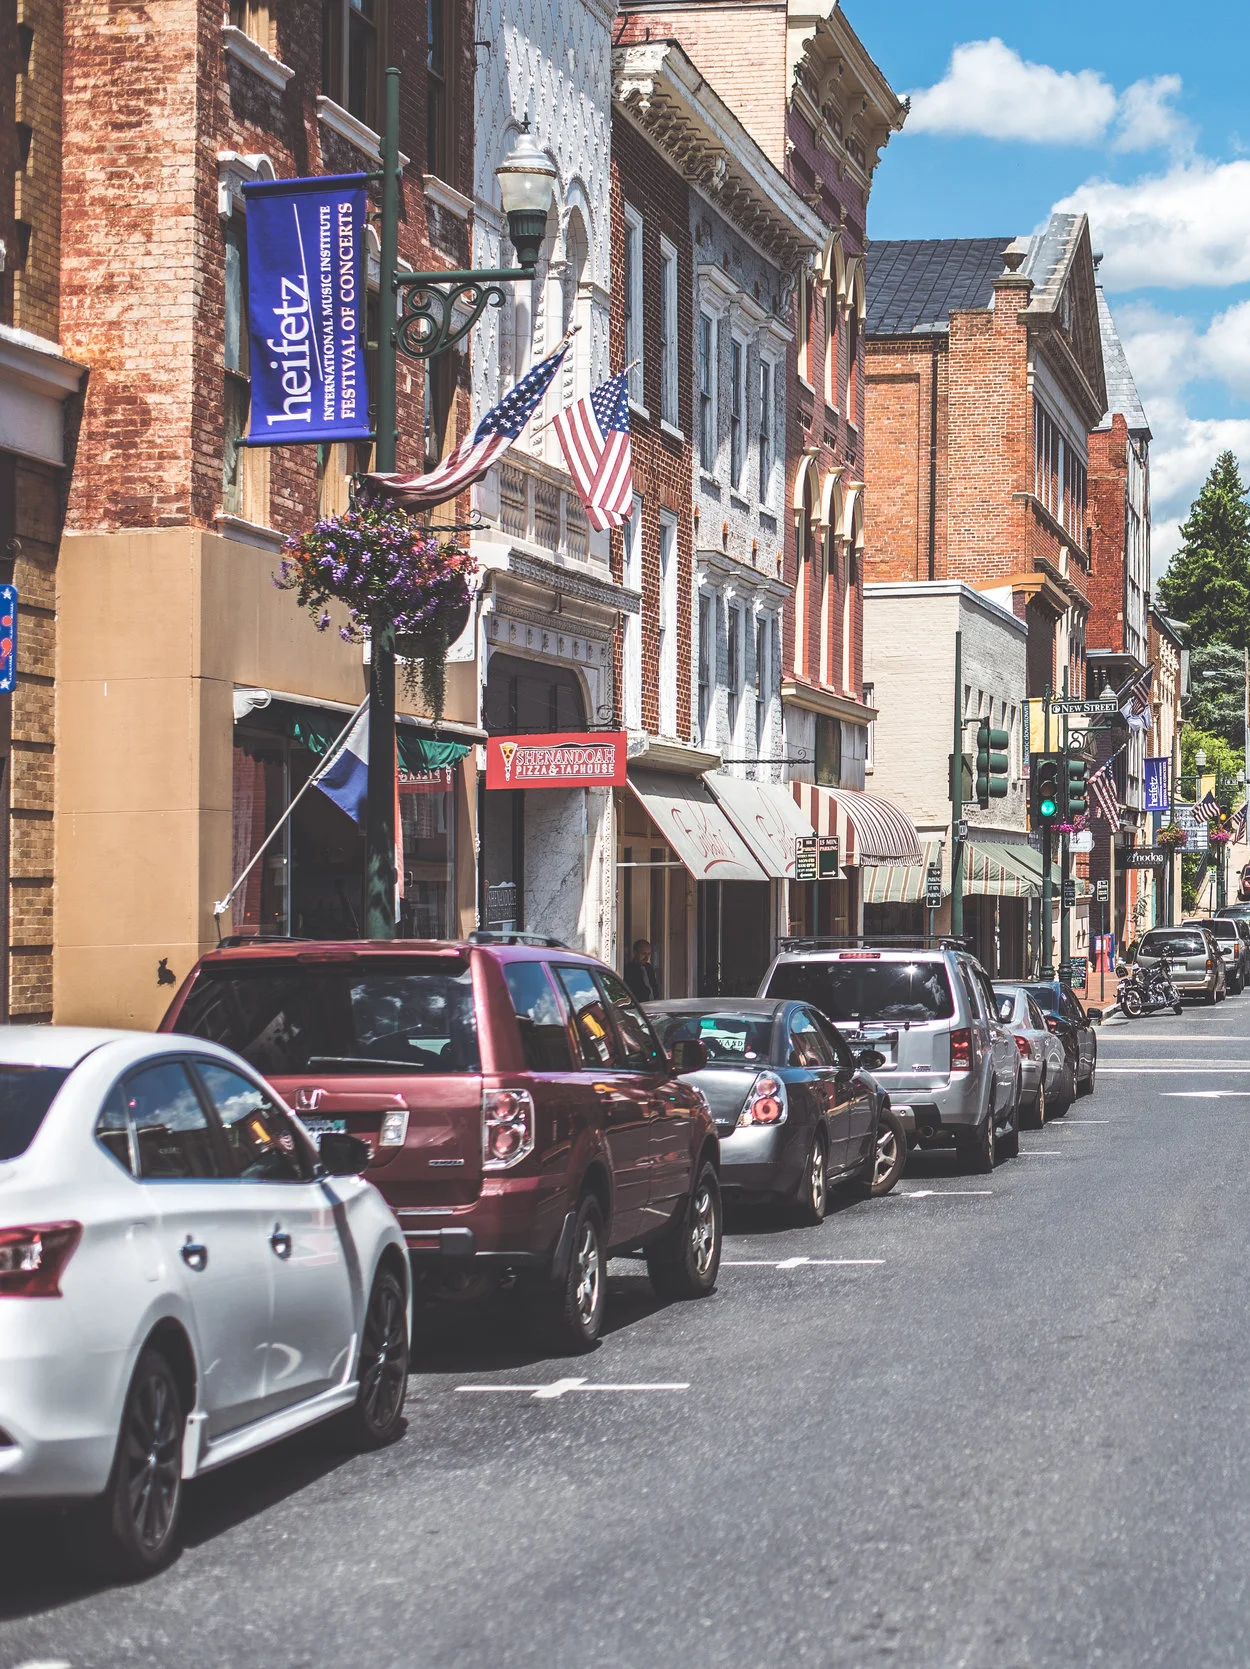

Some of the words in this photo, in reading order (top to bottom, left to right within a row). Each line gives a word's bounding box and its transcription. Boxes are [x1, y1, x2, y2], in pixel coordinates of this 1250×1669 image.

[319, 205, 331, 270] INSTITUTE
[338, 202, 355, 302] CONCERTS
[320, 273, 334, 318] MUSIC
[340, 307, 355, 332] OF
[266, 275, 312, 426] heifetz
[321, 321, 335, 421] INTERNATIONAL
[341, 334, 356, 420] FESTIVAL
[1061, 704, 1081, 713] NEW
[1083, 702, 1116, 712] STREET
[515, 748, 616, 766] SHENANDOAH
[516, 765, 548, 775] PIZZA
[560, 763, 615, 774] TAPHOUSE
[1148, 775, 1158, 807] heifetz
